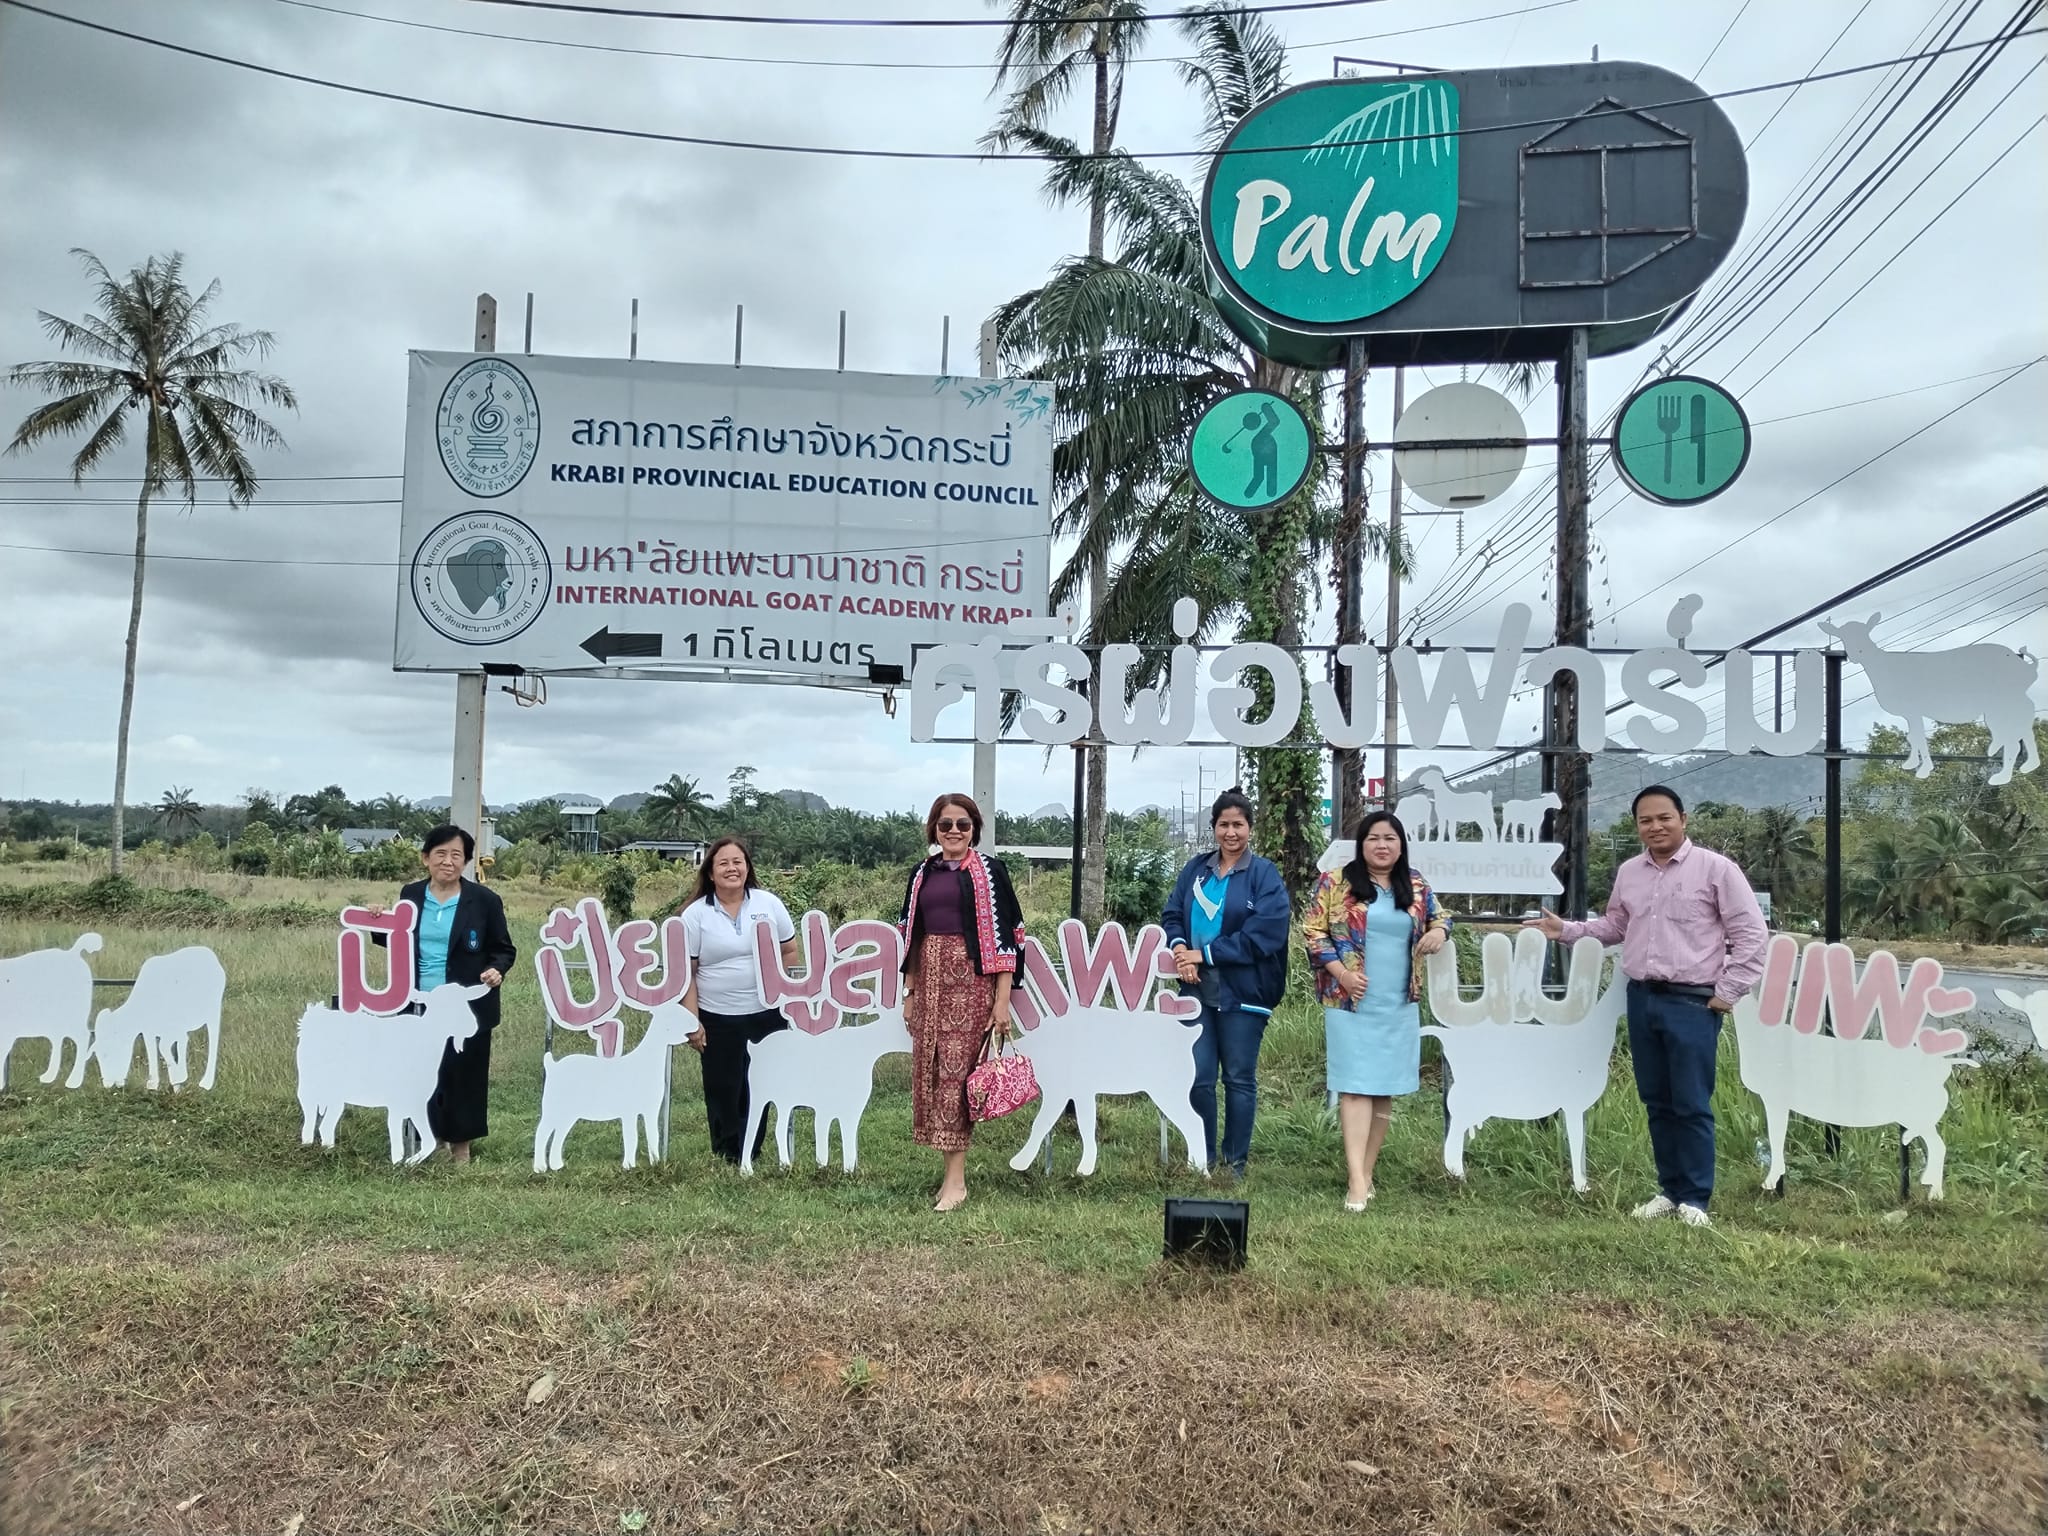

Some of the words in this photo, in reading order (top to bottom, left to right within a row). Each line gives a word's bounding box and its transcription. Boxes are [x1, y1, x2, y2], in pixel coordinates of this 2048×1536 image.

[1232, 176, 1442, 279] Palm
[570, 416, 1012, 466] สภาการศึกษาจังหวัดกระบี่
[550, 464, 624, 484] KRABI
[632, 467, 781, 491] PROVINCIAL
[788, 474, 926, 499] EDUCATION
[933, 482, 1039, 506] COUNCIL
[424, 523, 467, 569] International
[468, 521, 490, 530] Goat
[492, 522, 527, 547] Academy
[524, 545, 541, 571] Krabi
[565, 539, 926, 588] มหา'ลัยแพะนานาชาติ
[940, 549, 1024, 594] กระบี่
[556, 585, 759, 608] INTERNATIONAL
[766, 591, 833, 612] GOAT
[838, 595, 955, 621] ACADEMY
[682, 633, 699, 657] 1
[713, 626, 876, 666] กิโลเมตร
[910, 593, 1824, 756] ศรีผ่องฟาร์ม
[338, 899, 418, 1016] มี
[535, 897, 691, 1058] ปุ๋ย
[752, 909, 904, 1036] มูล
[1010, 918, 1202, 1033] แพะ
[1427, 928, 1603, 1026] นม
[1758, 934, 1977, 1055] แพะ
